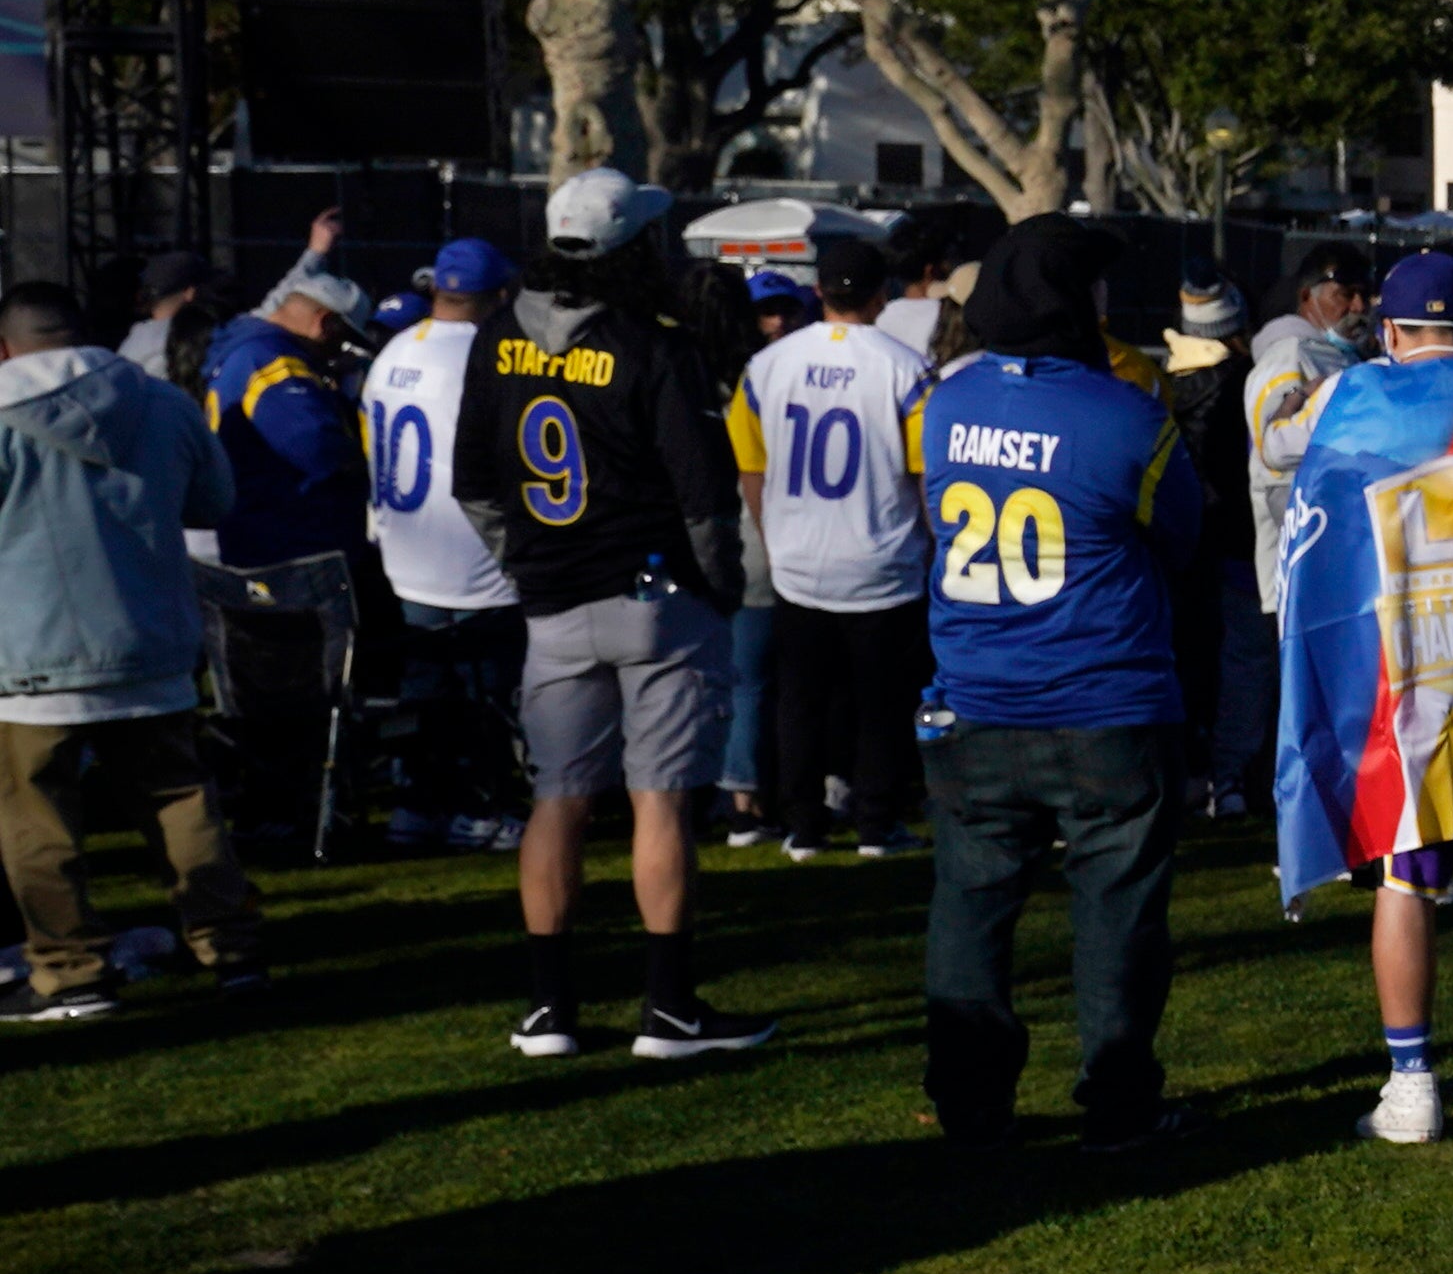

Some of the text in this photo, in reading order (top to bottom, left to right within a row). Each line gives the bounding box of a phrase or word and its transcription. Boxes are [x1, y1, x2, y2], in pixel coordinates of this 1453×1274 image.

[386, 366, 423, 392] KUPP
[496, 338, 616, 387] STAFFORD
[804, 364, 856, 391] KUPP
[372, 399, 433, 513] 10
[517, 394, 589, 526] 9
[785, 400, 863, 501] 10
[947, 423, 1061, 473] RAMSEY
[939, 480, 1067, 607] 20
